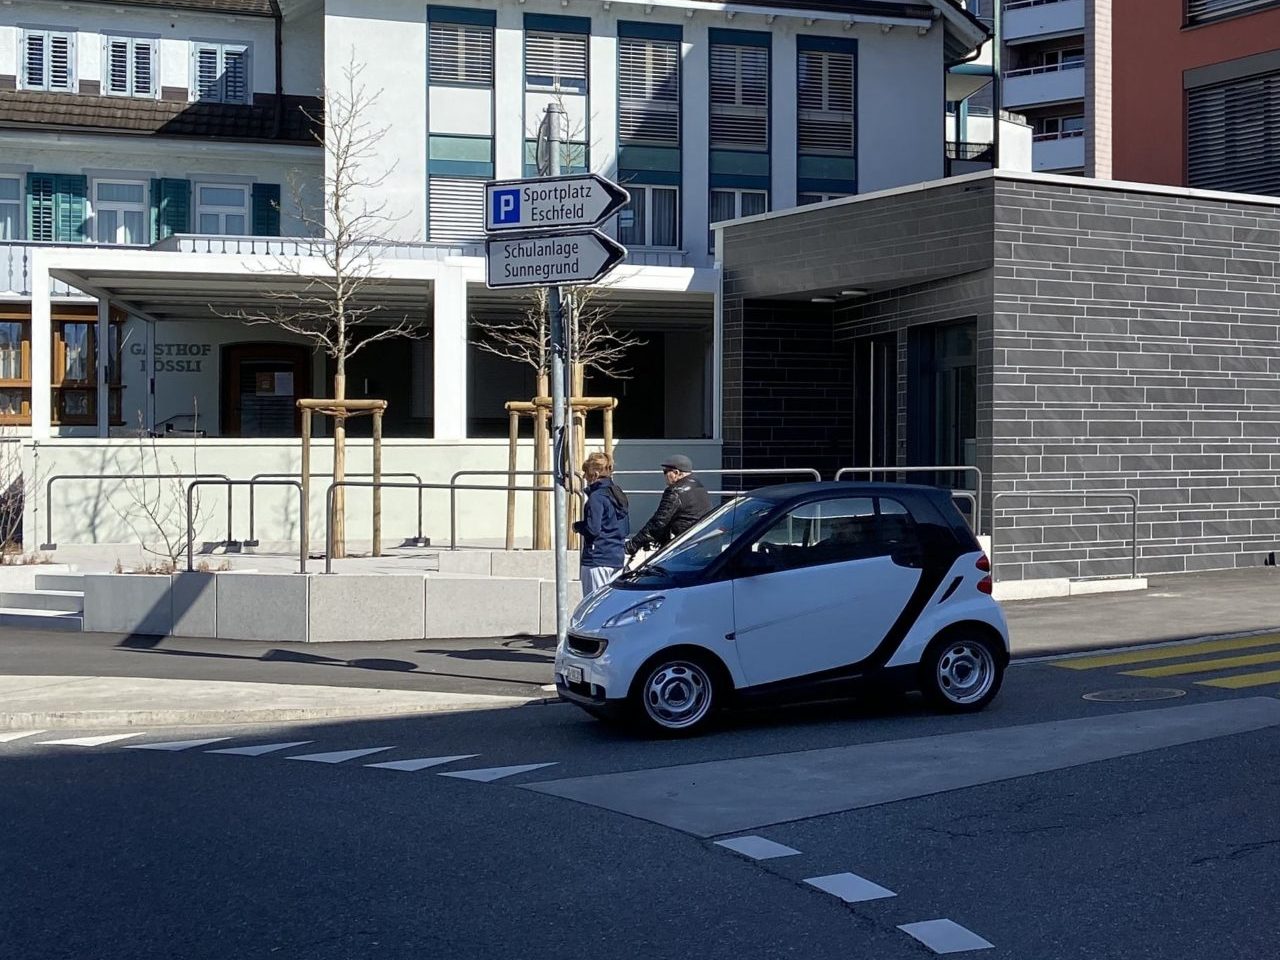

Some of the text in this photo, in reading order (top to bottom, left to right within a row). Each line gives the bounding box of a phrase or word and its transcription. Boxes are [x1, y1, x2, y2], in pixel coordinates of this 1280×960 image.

[523, 184, 592, 205] Sportplatz
[500, 194, 514, 221] P
[531, 203, 584, 221] Eschfeld
[504, 240, 579, 259] Schulanlage
[504, 258, 579, 279] Sunnegrund
